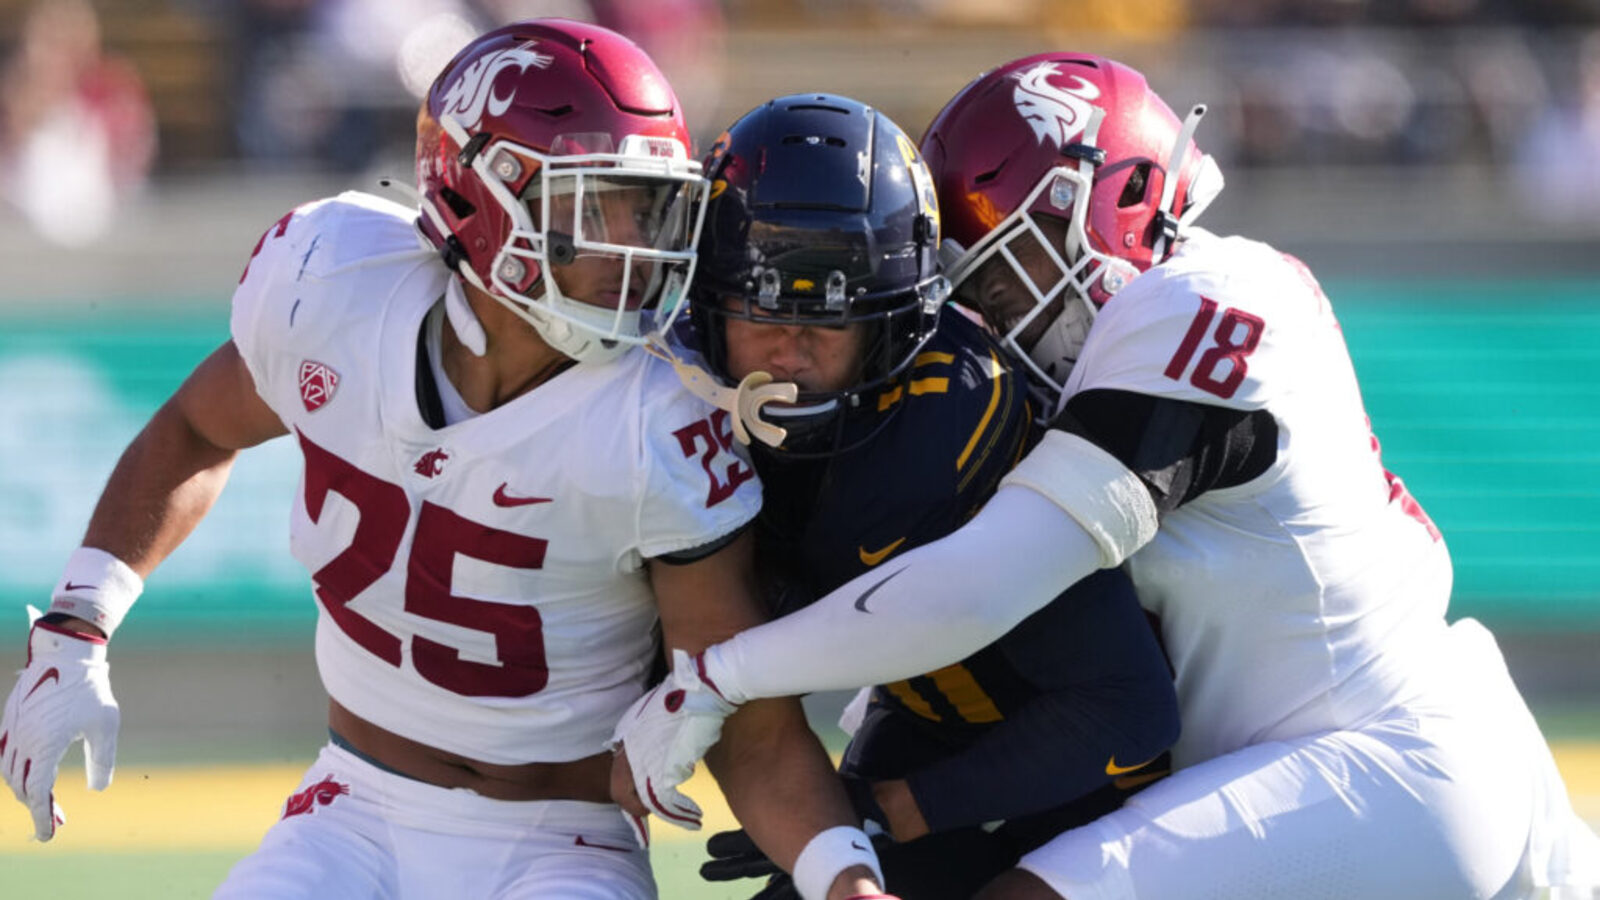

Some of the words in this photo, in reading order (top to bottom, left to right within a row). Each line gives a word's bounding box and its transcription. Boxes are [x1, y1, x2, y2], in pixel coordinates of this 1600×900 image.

[300, 362, 338, 400] PAC
[1164, 294, 1266, 400] 18
[304, 383, 325, 406] 12
[294, 424, 549, 699] 25
